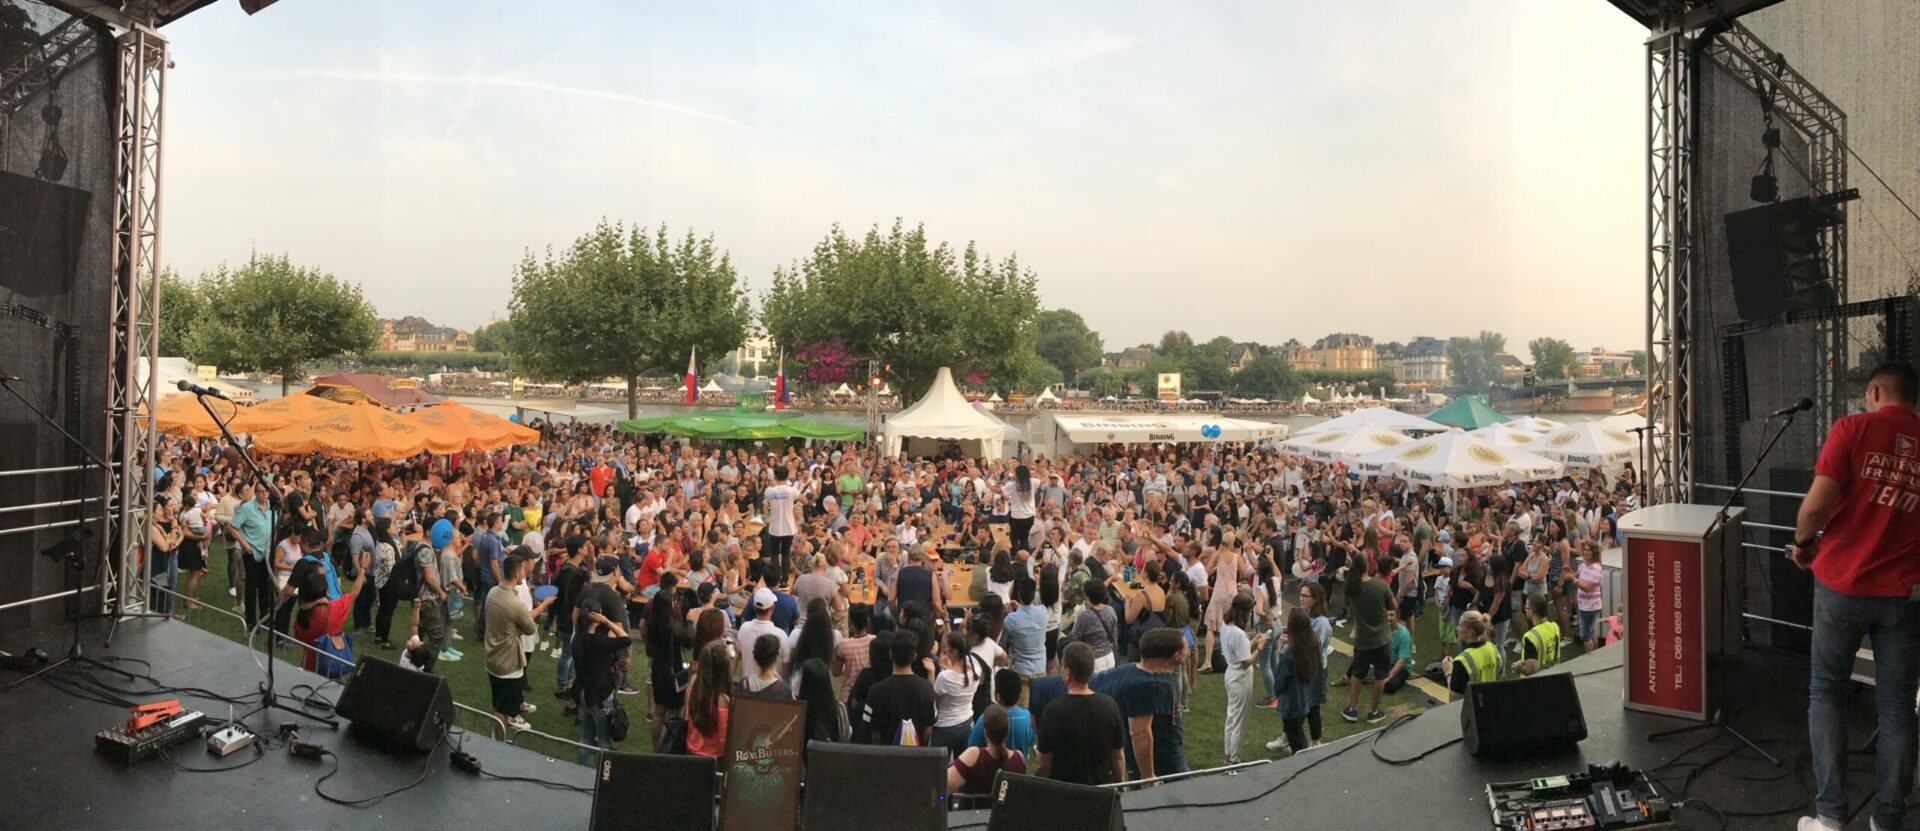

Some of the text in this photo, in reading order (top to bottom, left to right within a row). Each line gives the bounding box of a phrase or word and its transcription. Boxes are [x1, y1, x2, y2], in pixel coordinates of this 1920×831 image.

[1567, 454, 1590, 464] BINDING
[1865, 467, 1920, 488] FRANKFU
[1648, 552, 1656, 693] ANTENNE-FRANKFURT.DE
[1674, 636, 1682, 660] 069
[1674, 665, 1682, 690] TEL.:
[603, 760, 611, 780] NEXO
[998, 780, 1008, 801] NEXO
